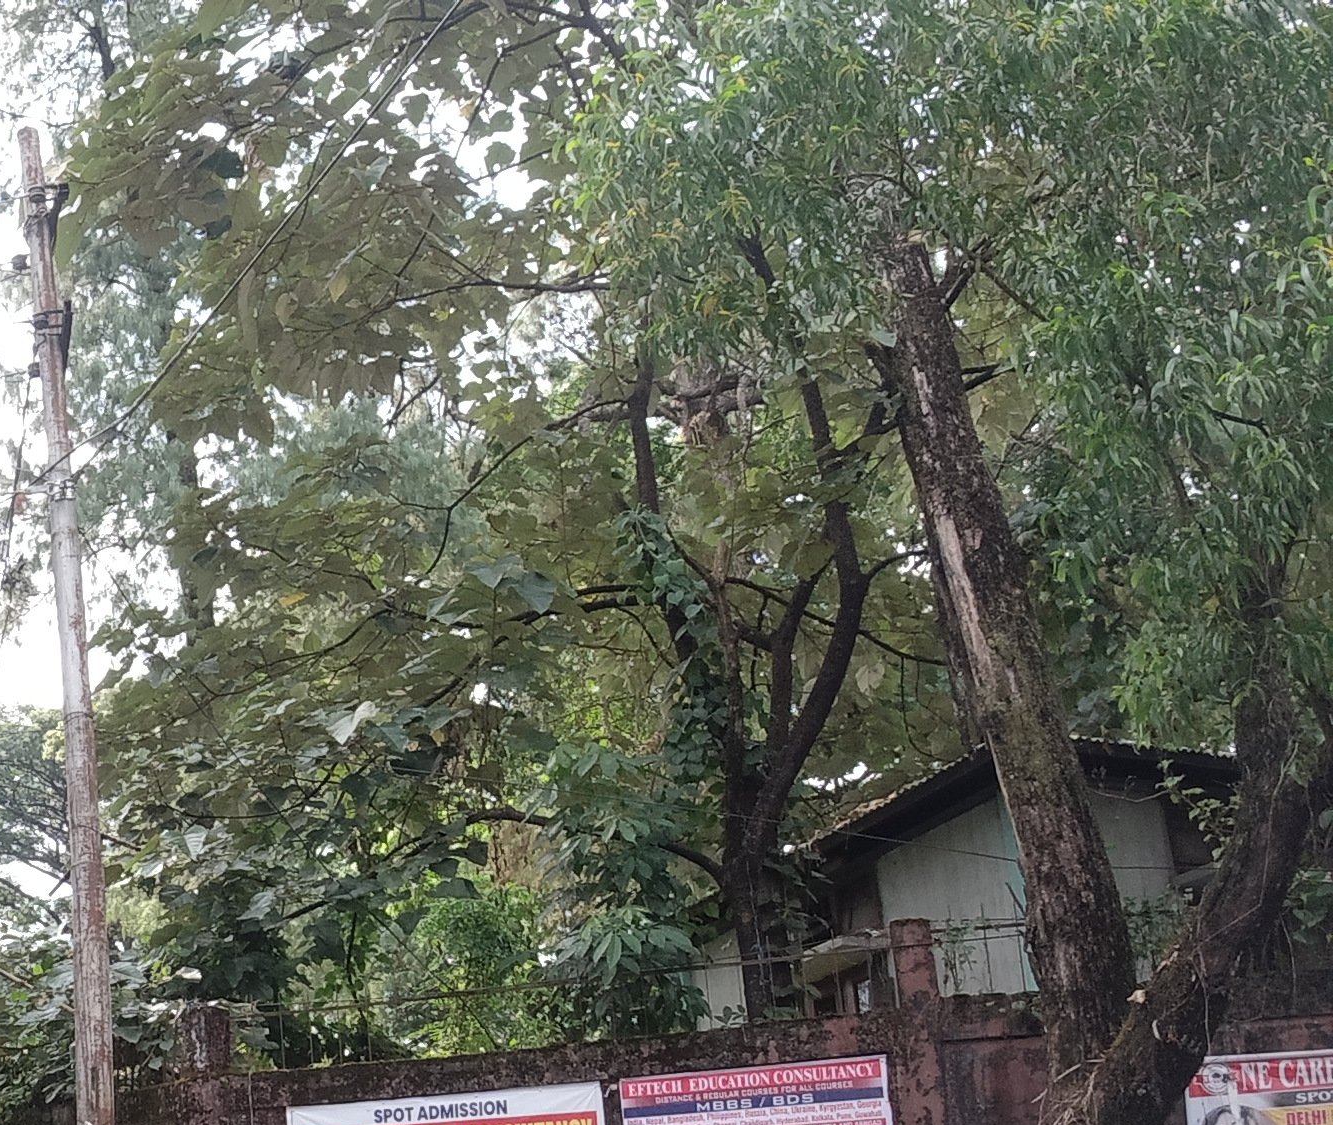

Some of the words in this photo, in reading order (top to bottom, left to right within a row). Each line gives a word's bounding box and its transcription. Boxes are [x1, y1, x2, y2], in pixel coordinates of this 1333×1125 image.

[628, 1080, 682, 1098] EFTECH
[688, 1070, 770, 1092] EDUCATION
[773, 1061, 875, 1085] CONSULTANCY
[1241, 1062, 1273, 1091] NE
[655, 1094, 694, 1104] DISTANCE
[703, 1089, 740, 1100] REGULAR
[741, 1085, 779, 1098] COURSES
[781, 1084, 797, 1094] FOR
[799, 1083, 814, 1092] ALL
[815, 1079, 853, 1091] COURSES
[696, 1098, 753, 1112] MBBS
[773, 1093, 814, 1106] BDS
[1295, 1091, 1333, 1104] SPO
[373, 1106, 414, 1124] SPOT
[418, 1099, 508, 1122] ADMISSION
